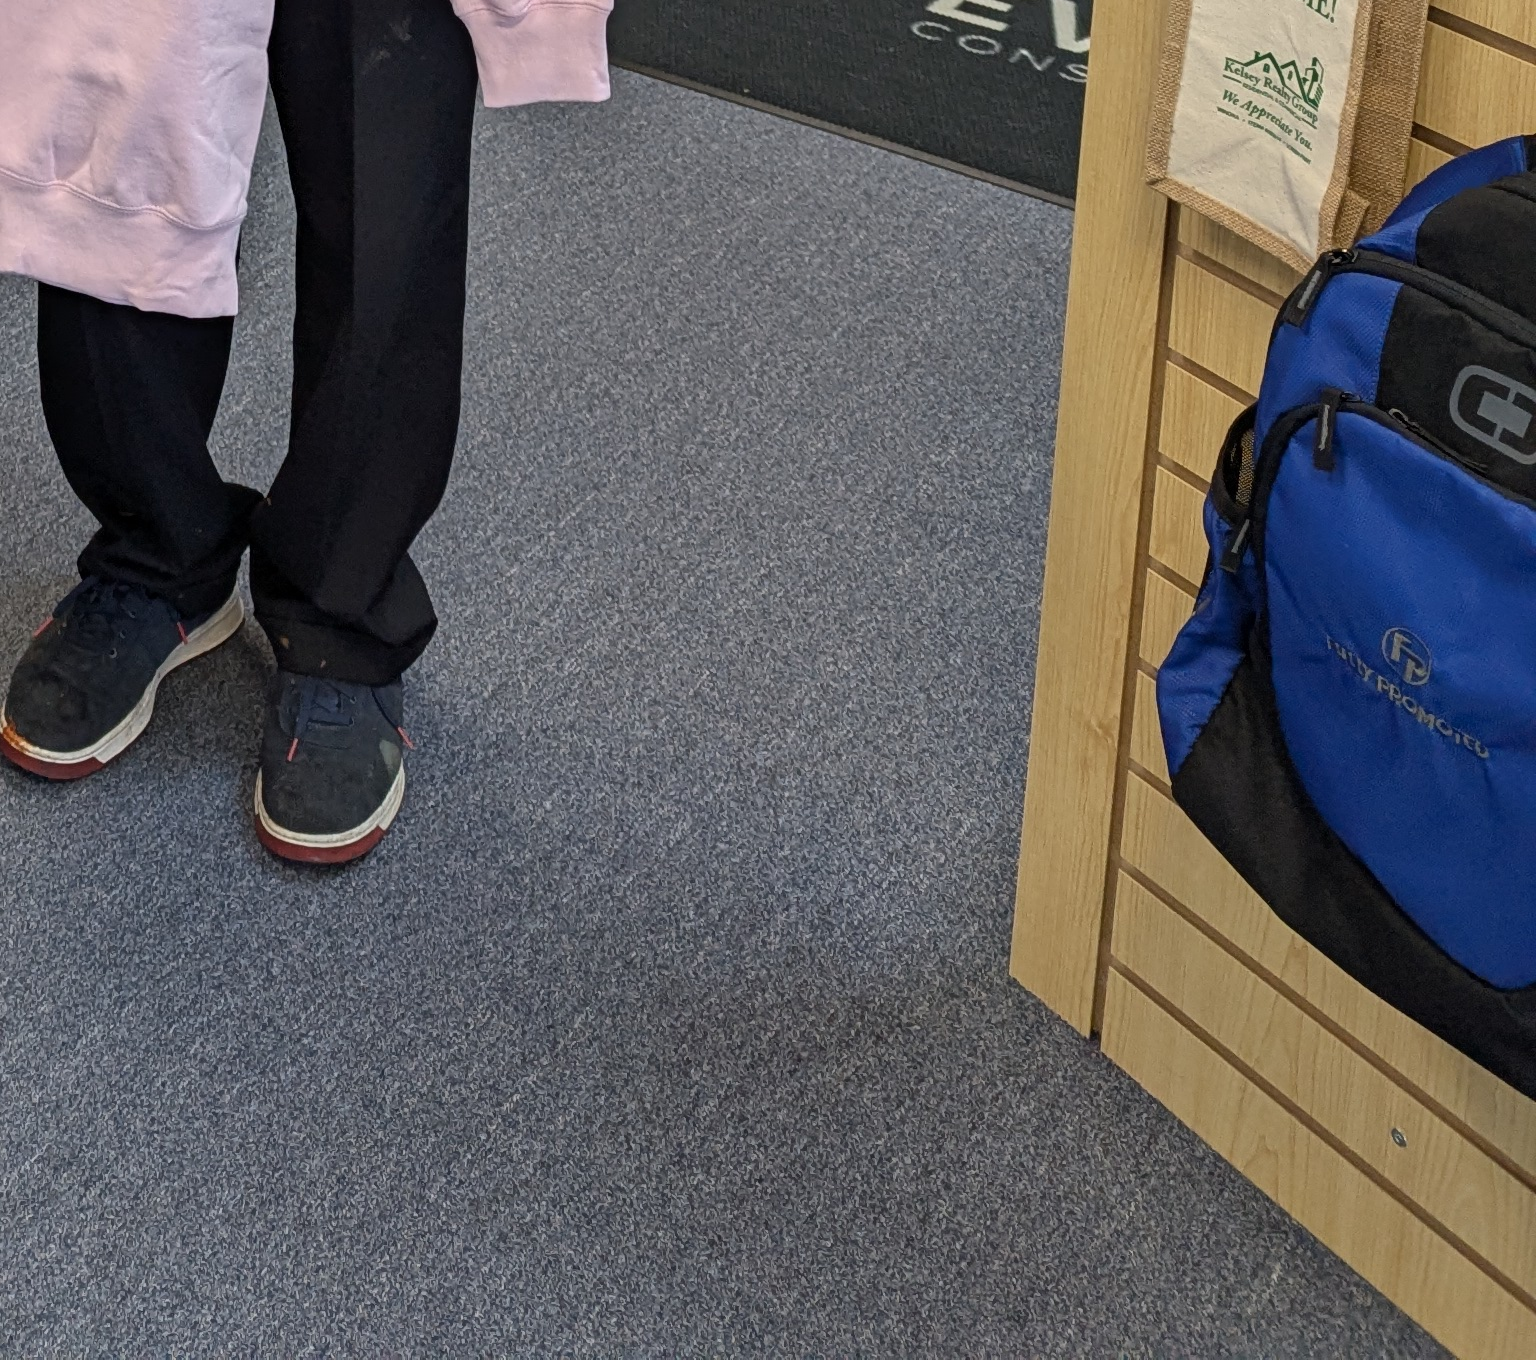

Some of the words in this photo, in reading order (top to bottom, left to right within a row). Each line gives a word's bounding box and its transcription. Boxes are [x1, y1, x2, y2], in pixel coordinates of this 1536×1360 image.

[1222, 89, 1240, 106] We
[1240, 100, 1294, 136] Appreciate
[1294, 128, 1313, 151] You.
[1223, 60, 1261, 86] Kelsey
[1263, 76, 1291, 104] Realty
[1291, 95, 1319, 125] Group
[1376, 675, 1490, 759] PROMOTED
